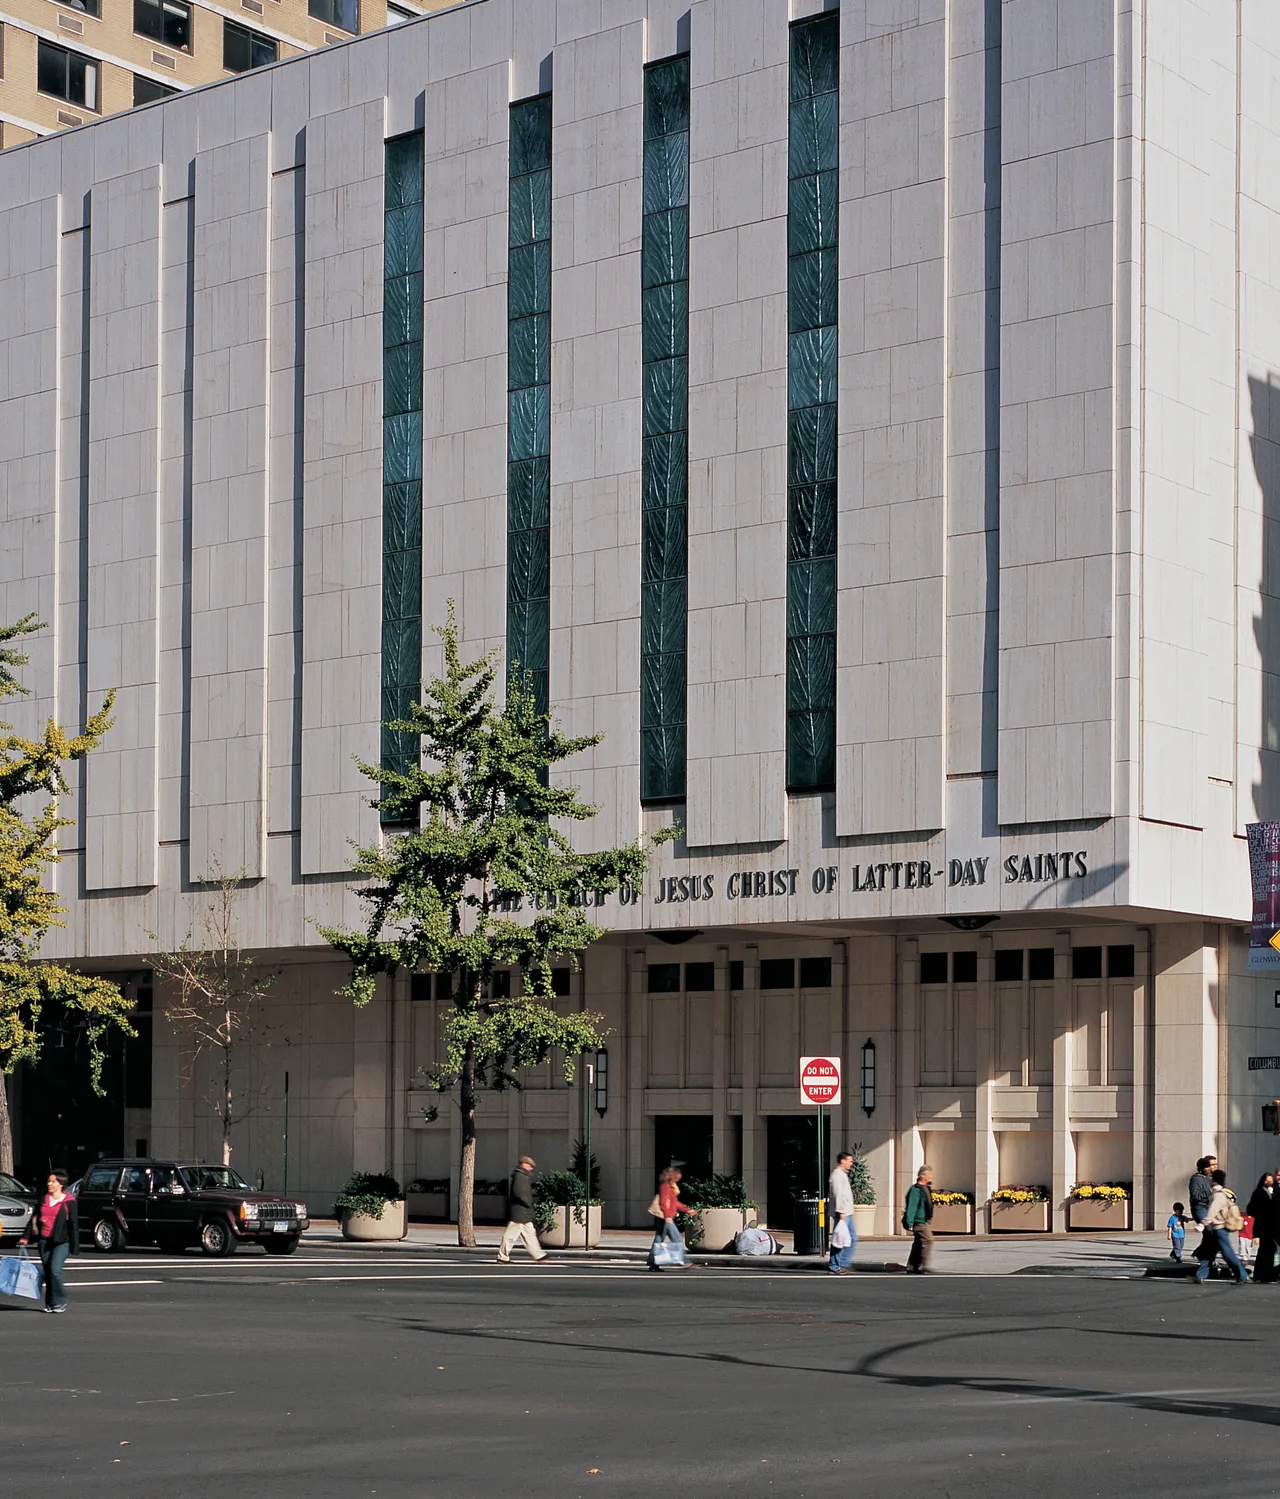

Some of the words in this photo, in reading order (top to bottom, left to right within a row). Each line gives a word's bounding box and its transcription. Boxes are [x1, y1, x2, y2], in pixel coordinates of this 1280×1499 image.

[1248, 830, 1262, 840] THE
[655, 874, 715, 904] JESUS
[727, 868, 800, 901] CHRIST
[812, 865, 839, 895] OF
[852, 856, 990, 893] LATTER-DAY
[1004, 851, 1088, 884] SAINTS
[807, 1067, 818, 1075] DO
[819, 1067, 834, 1075] NOT
[809, 1087, 832, 1095] ENTER
